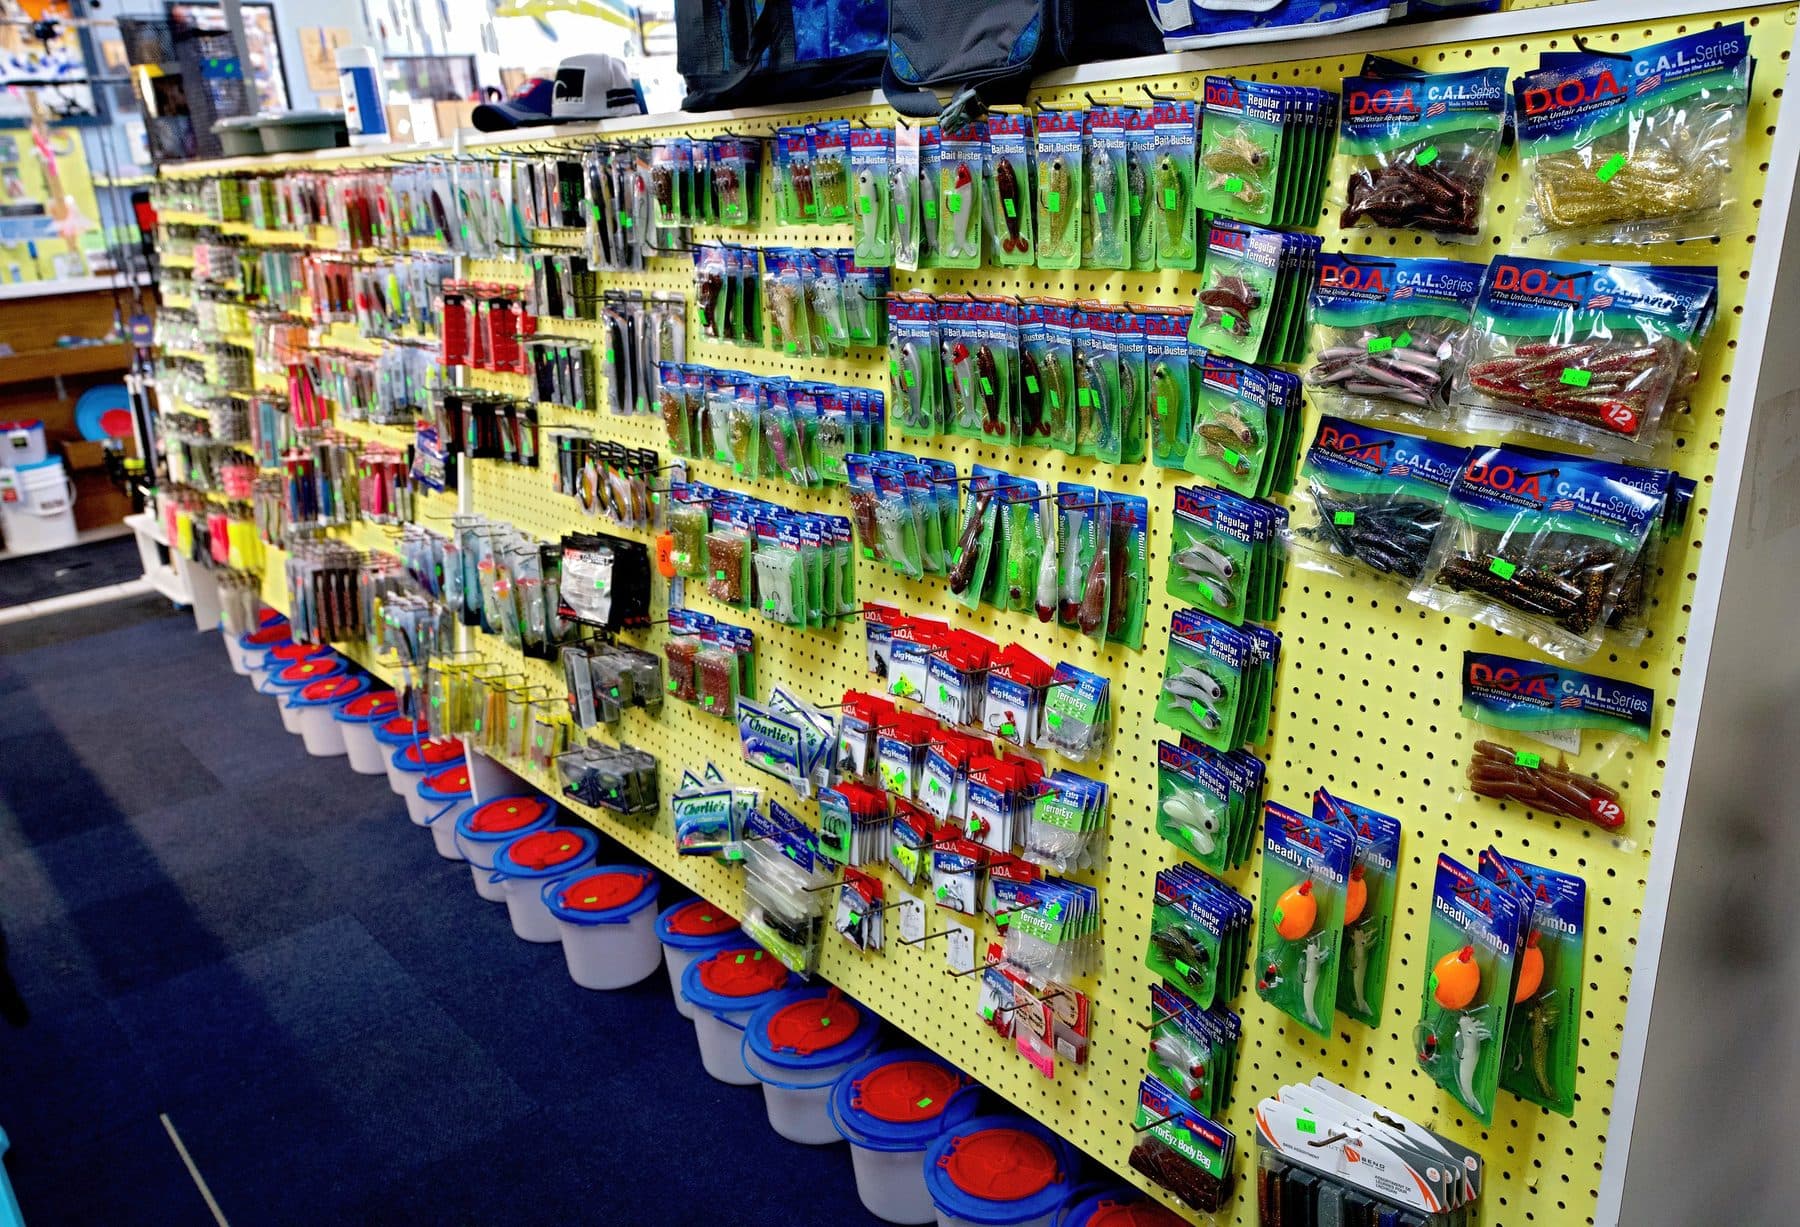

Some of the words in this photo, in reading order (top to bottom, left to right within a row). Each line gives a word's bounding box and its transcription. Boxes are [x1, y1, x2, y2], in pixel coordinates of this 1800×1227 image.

[1696, 40, 1739, 63] Series
[1247, 93, 1280, 110] Regular
[1349, 87, 1422, 115] D.O.A.
[1523, 70, 1628, 116] D.O.A.
[1246, 105, 1281, 123] TerrorEyz
[1550, 106, 1575, 120] Unfair
[991, 144, 1005, 154] Bait
[1005, 144, 1025, 153] Buster
[1038, 143, 1054, 152] Bait
[1055, 142, 1081, 153] Buster
[1092, 138, 1105, 148] Bait
[1106, 138, 1125, 148] Buster
[1154, 135, 1170, 145] Bait
[1171, 135, 1193, 145] Buster
[940, 150, 957, 161] Bait
[1249, 238, 1277, 255] Regular
[1246, 248, 1277, 267] TerrorEyz
[1320, 265, 1390, 293] D.O.A.
[1440, 274, 1474, 293] Series
[1493, 264, 1584, 300] D.O.A.
[1332, 288, 1349, 296] Unfair
[897, 329, 911, 338] Bait
[948, 328, 961, 338] Bait
[977, 329, 989, 339] Bait
[1091, 338, 1102, 349] Bait
[1148, 345, 1163, 355] Bait
[1164, 345, 1187, 356] Buster
[1243, 376, 1266, 396] Regular
[1606, 404, 1633, 427] 12
[1331, 451, 1347, 463] Unfair
[1464, 458, 1547, 502] D.O.A.
[1479, 485, 1499, 499] Unfair
[1606, 495, 1646, 520] Series
[1217, 511, 1249, 531] Regular
[779, 532, 799, 545] Shrimp
[800, 528, 820, 541] Shrimp
[1215, 520, 1251, 543] TerrorEyz
[1137, 531, 1146, 561] Mullet
[1211, 635, 1238, 656] Regular
[893, 651, 905, 661] Jig
[1209, 645, 1239, 667] TerrorEyz
[931, 665, 942, 678] Jig
[1469, 662, 1556, 700] D.O.A.
[990, 687, 1002, 698] Jig
[1056, 688, 1087, 712] TerrorEyz
[1490, 687, 1511, 698] Unfair
[1611, 690, 1648, 713] Series
[749, 717, 795, 746] Charlie's
[1198, 775, 1227, 802] TerrorEyz
[1199, 767, 1226, 791] Regular
[683, 800, 725, 816] Charlie's
[971, 792, 983, 805] Jig
[1597, 799, 1620, 820] 12
[1267, 838, 1303, 867] Deadly
[938, 861, 950, 871] Jig
[1019, 910, 1053, 931] TerrorEyz
[1192, 901, 1220, 926] Regular
[1436, 895, 1472, 930] Deadly
[1189, 910, 1220, 936] TerrorEyz
[1177, 1138, 1196, 1159] Body
[1196, 1149, 1211, 1169] Bag
